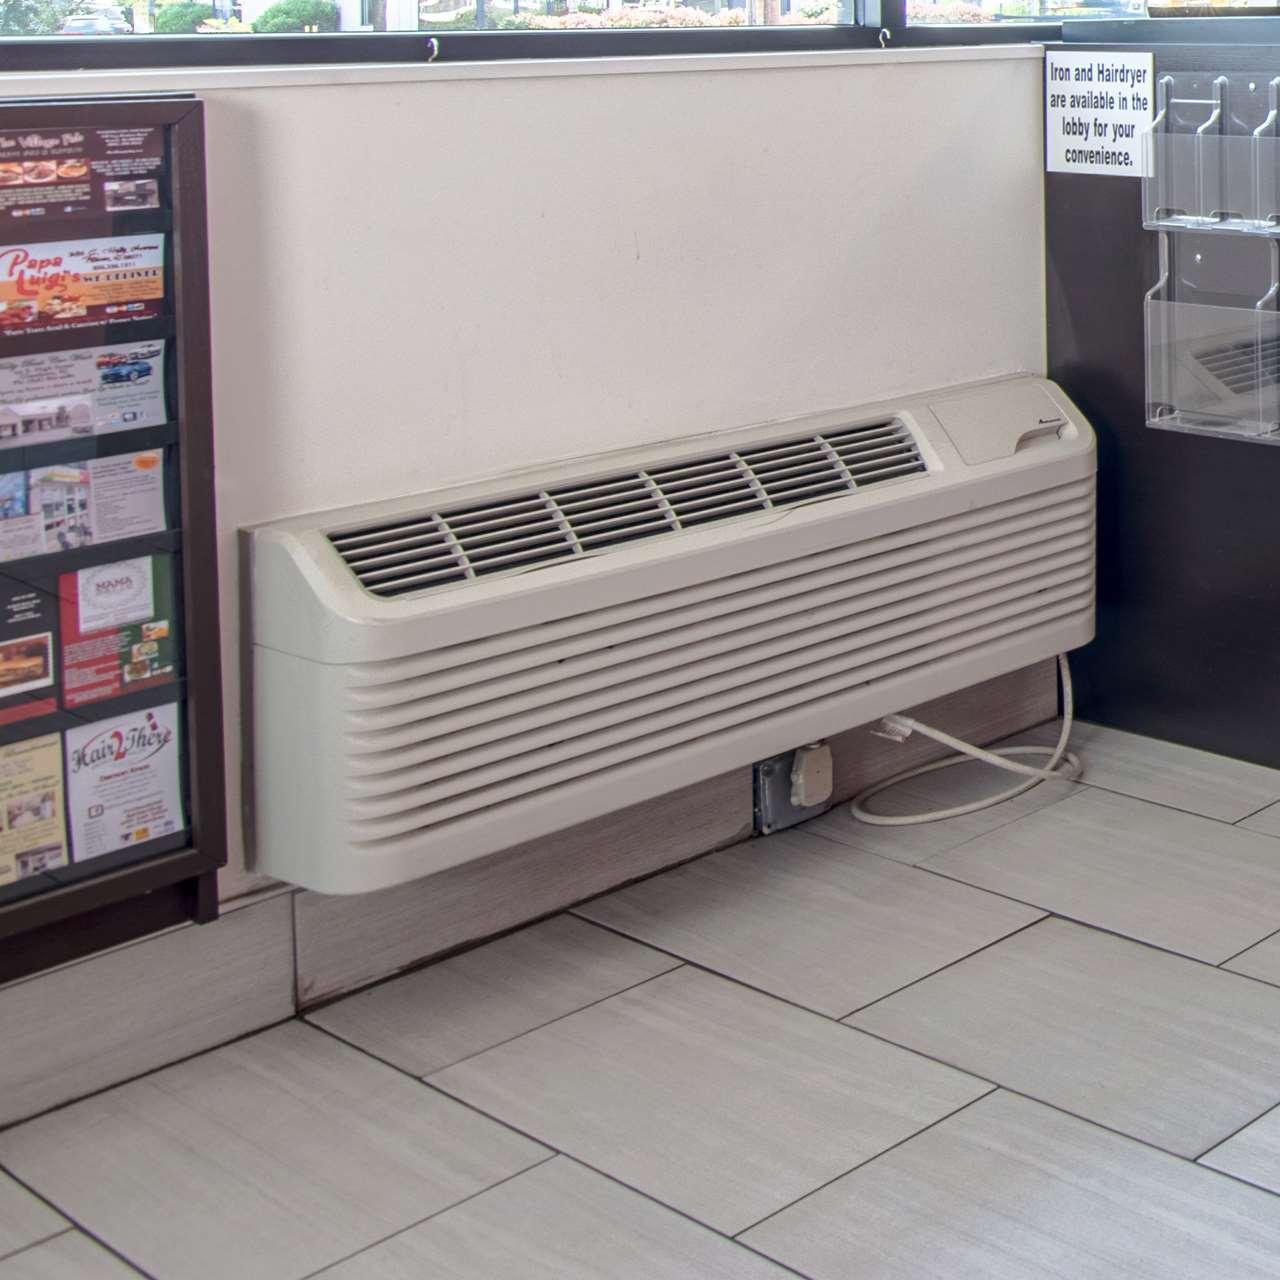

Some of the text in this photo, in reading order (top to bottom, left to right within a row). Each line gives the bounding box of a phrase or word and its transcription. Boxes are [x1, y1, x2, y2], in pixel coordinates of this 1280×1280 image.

[1050, 62, 1147, 88] Iron and Hairdryer
[1050, 91, 1148, 111] are available in the
[1062, 116, 1135, 142] lobby for your
[1065, 146, 1133, 166] convenience.
[0, 248, 63, 278] Papa
[16, 269, 81, 296] Luigi's
